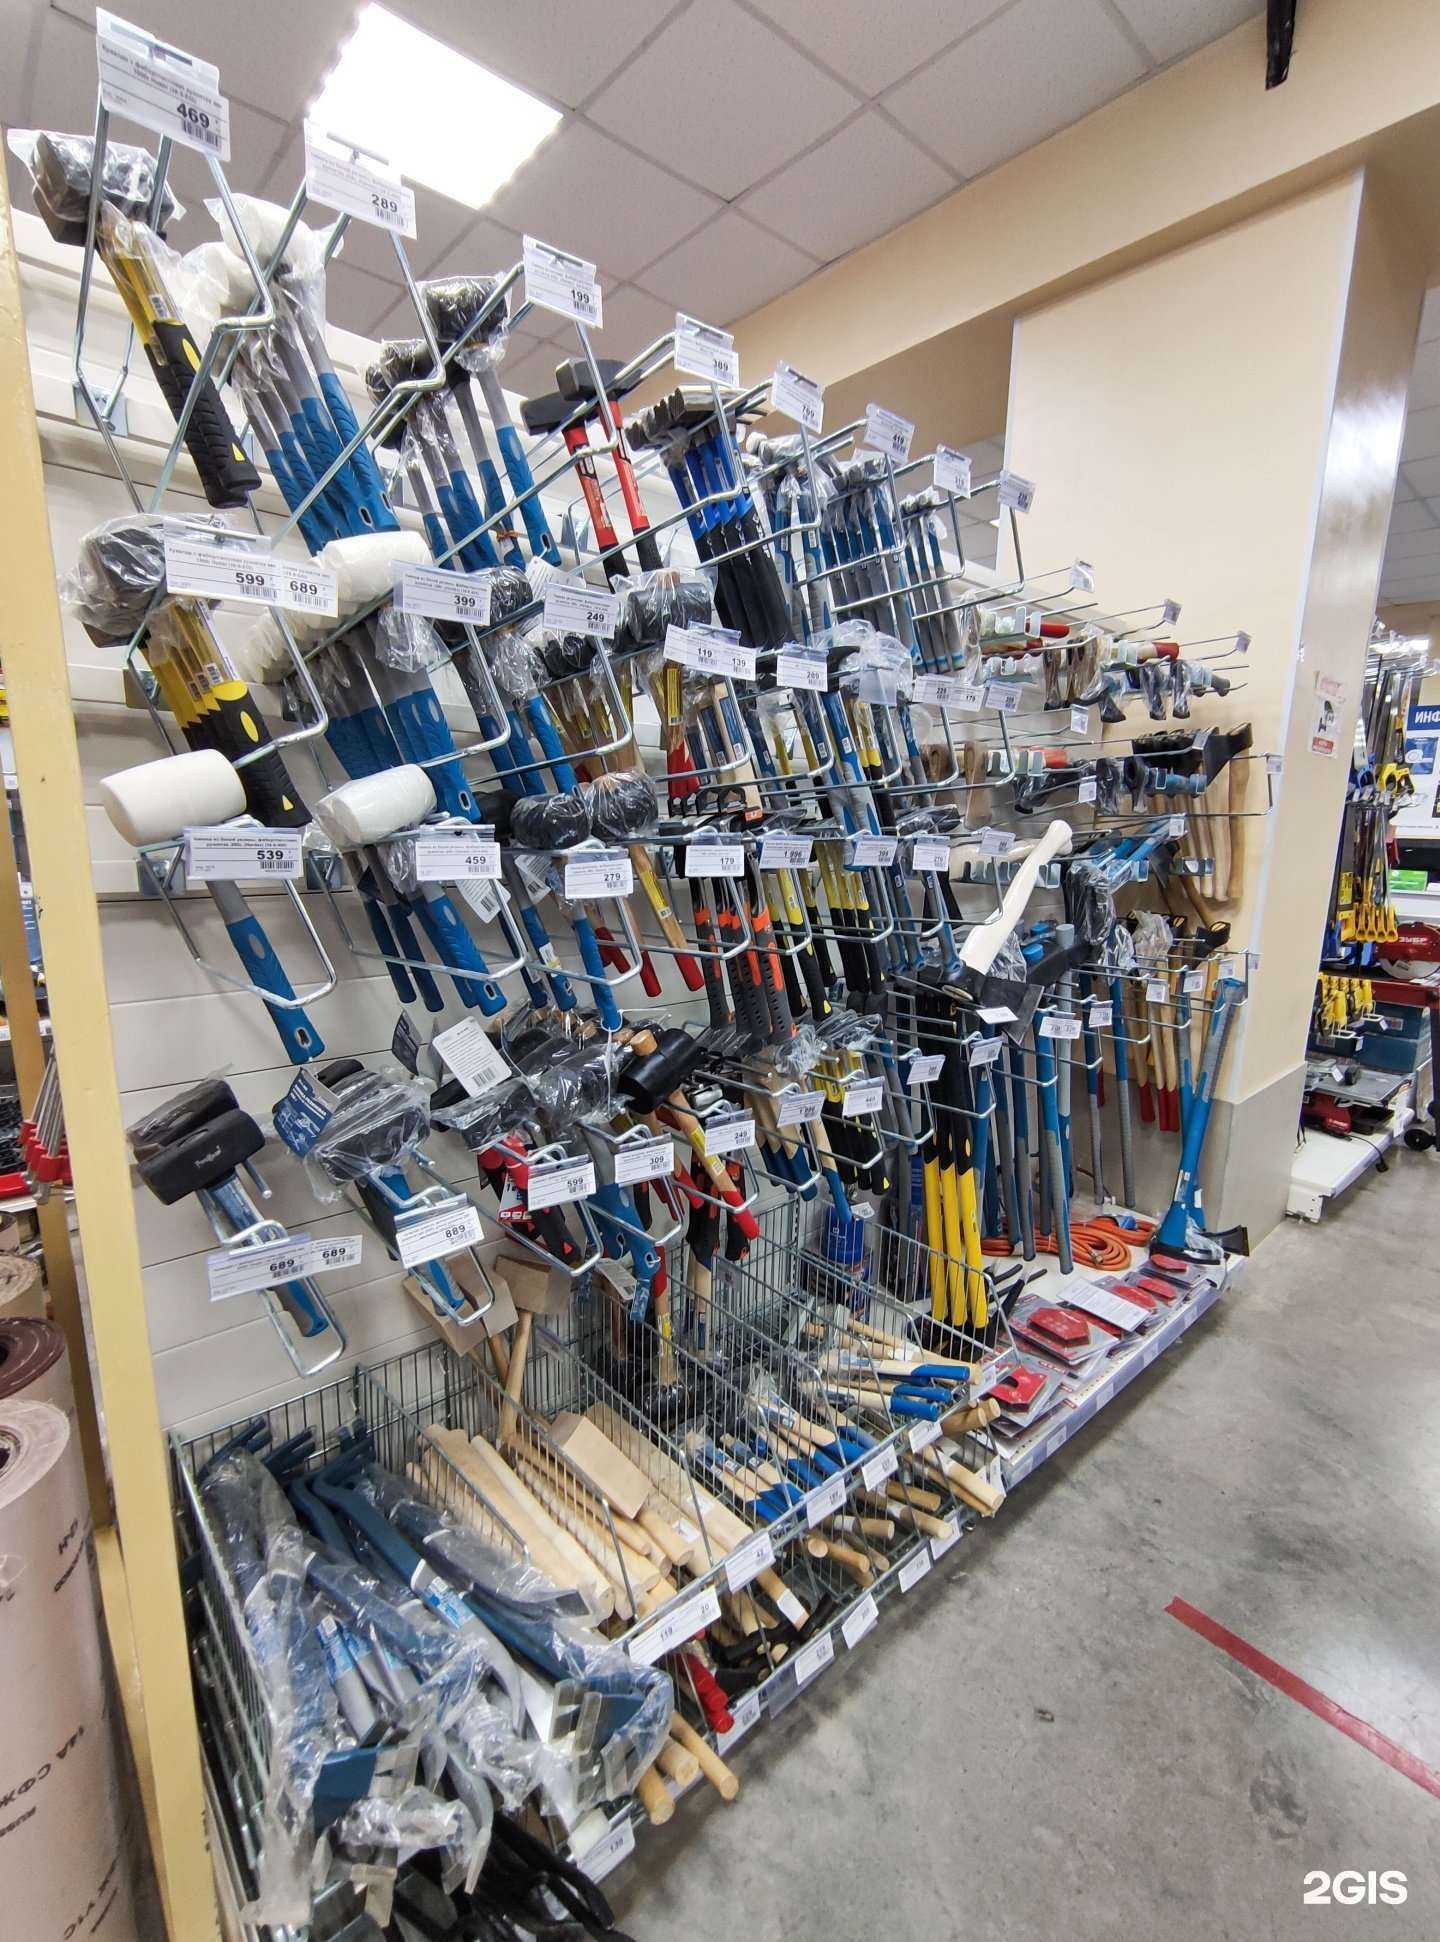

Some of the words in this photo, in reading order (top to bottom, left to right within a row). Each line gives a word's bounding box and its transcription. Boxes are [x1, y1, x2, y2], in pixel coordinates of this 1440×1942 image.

[177, 103, 209, 129] 469
[371, 193, 398, 213] 289
[571, 289, 590, 303] 199
[235, 572, 265, 586] 599
[290, 580, 318, 595] 689
[454, 595, 476, 607] 399
[586, 611, 605, 622] 249
[257, 849, 284, 860] 539
[465, 855, 487, 865] 459
[604, 872, 621, 881] 279
[567, 1177, 584, 1187] 599
[445, 1225, 466, 1238] 889
[322, 1248, 346, 1259] 689
[269, 1259, 295, 1272] 689
